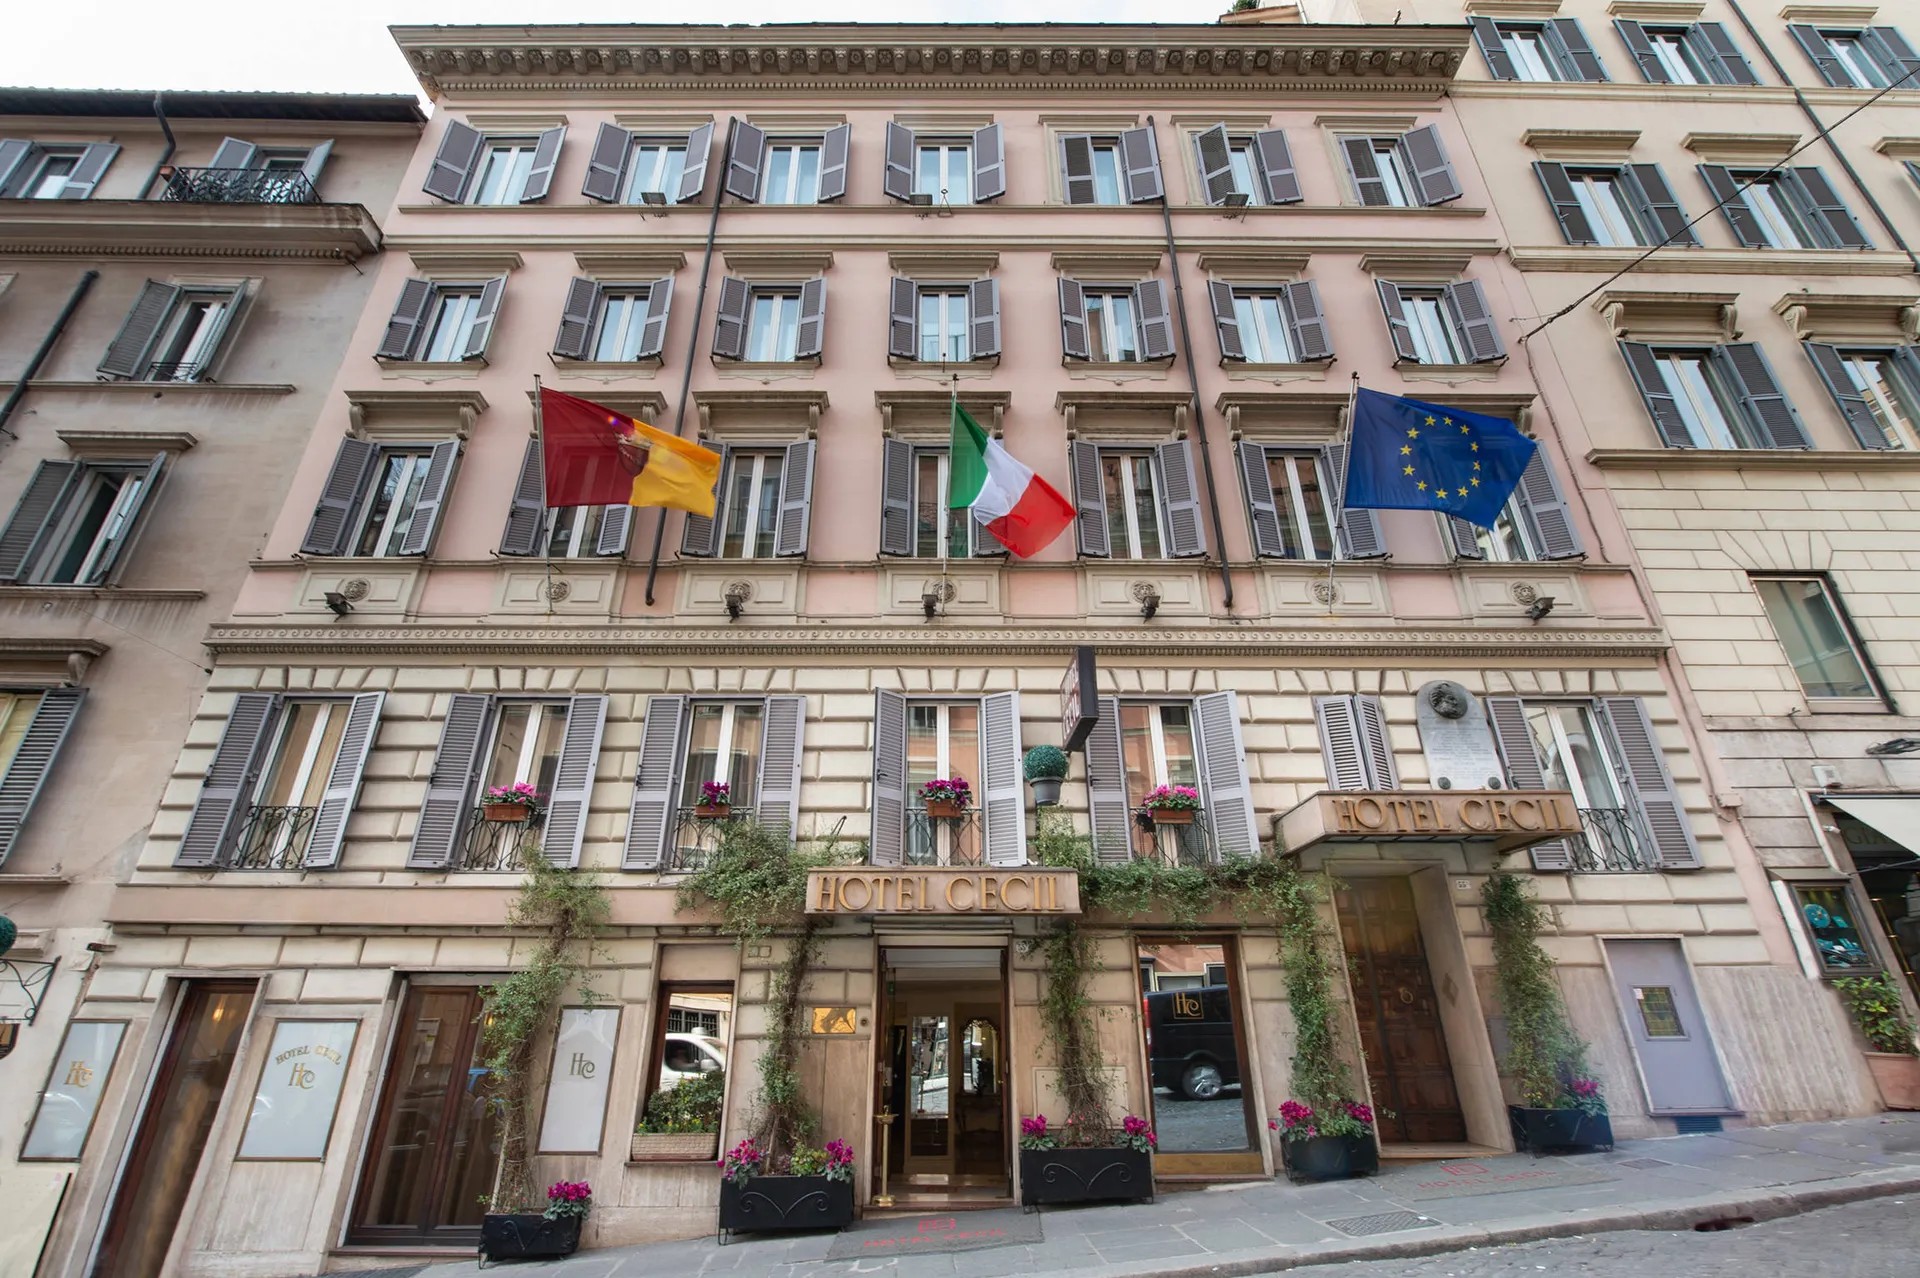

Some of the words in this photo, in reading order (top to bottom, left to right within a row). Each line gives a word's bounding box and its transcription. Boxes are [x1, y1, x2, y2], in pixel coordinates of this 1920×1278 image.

[1332, 798, 1450, 832] HOTEL
[1458, 799, 1575, 832] CECIL
[814, 875, 935, 912] HOTEL
[944, 875, 1065, 912] CECIL
[275, 1045, 311, 1065] HOTEL
